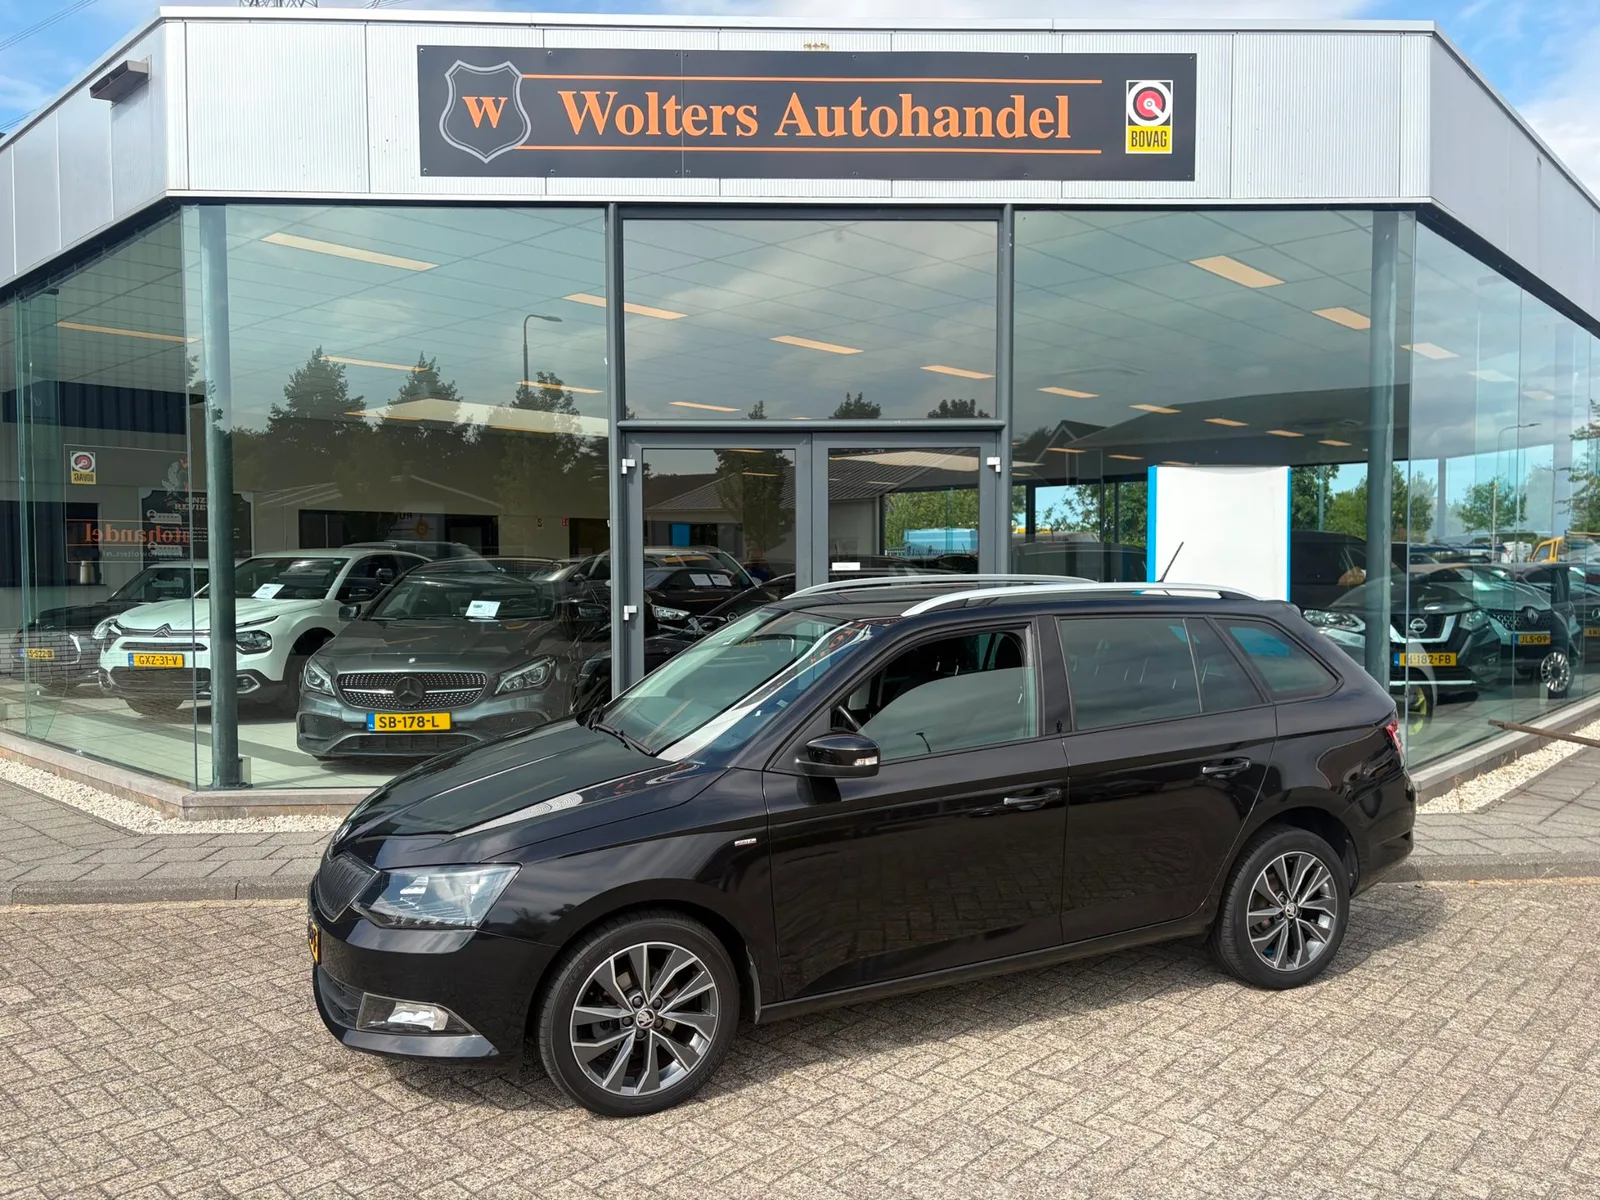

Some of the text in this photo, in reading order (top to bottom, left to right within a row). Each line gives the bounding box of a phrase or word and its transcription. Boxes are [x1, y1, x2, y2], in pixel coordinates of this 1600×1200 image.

[463, 96, 506, 127] W
[558, 90, 1070, 139] Wolters Autohandel
[1131, 130, 1167, 147] BOVAG
[139, 655, 178, 666] GXZ-31-V
[378, 716, 440, 729] SB-178-L
